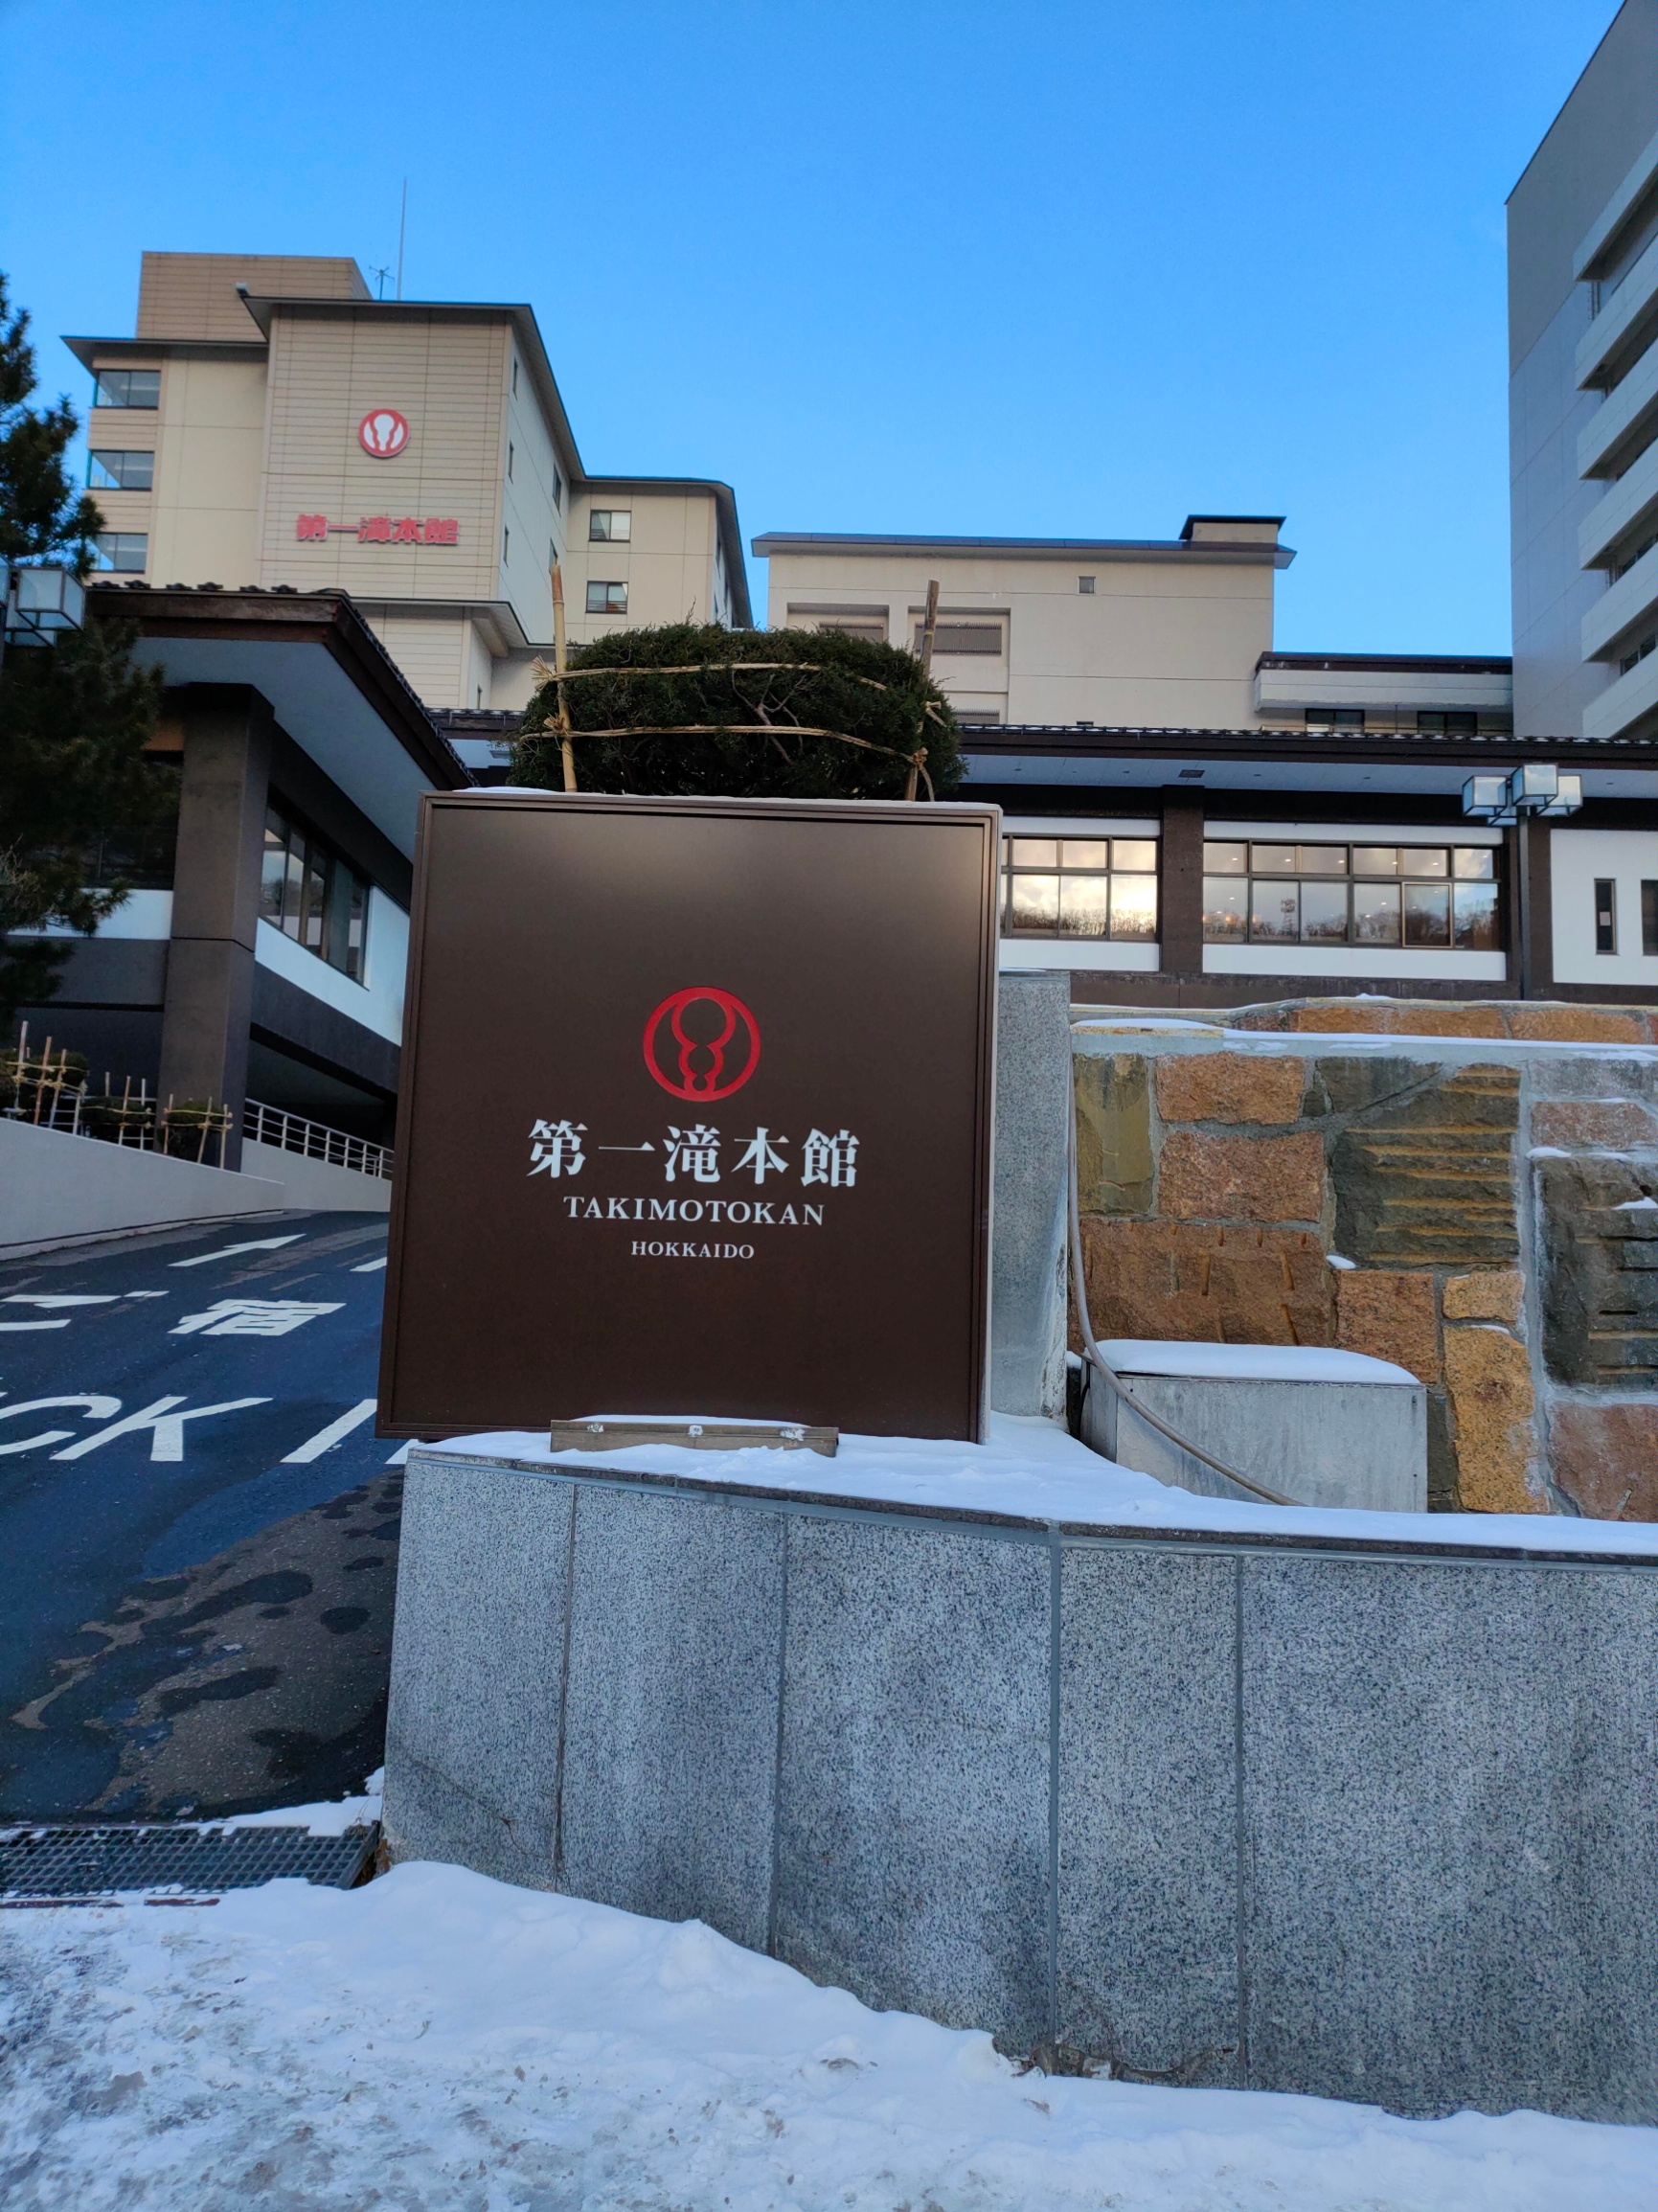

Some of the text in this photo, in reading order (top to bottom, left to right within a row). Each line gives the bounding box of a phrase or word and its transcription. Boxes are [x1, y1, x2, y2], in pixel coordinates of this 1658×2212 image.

[526, 1118, 860, 1188] 第一滝本館
[563, 1196, 825, 1226] TAKIMOTOKAN
[630, 1241, 755, 1260] HOKKAIDO
[0, 1378, 274, 1462] CK
